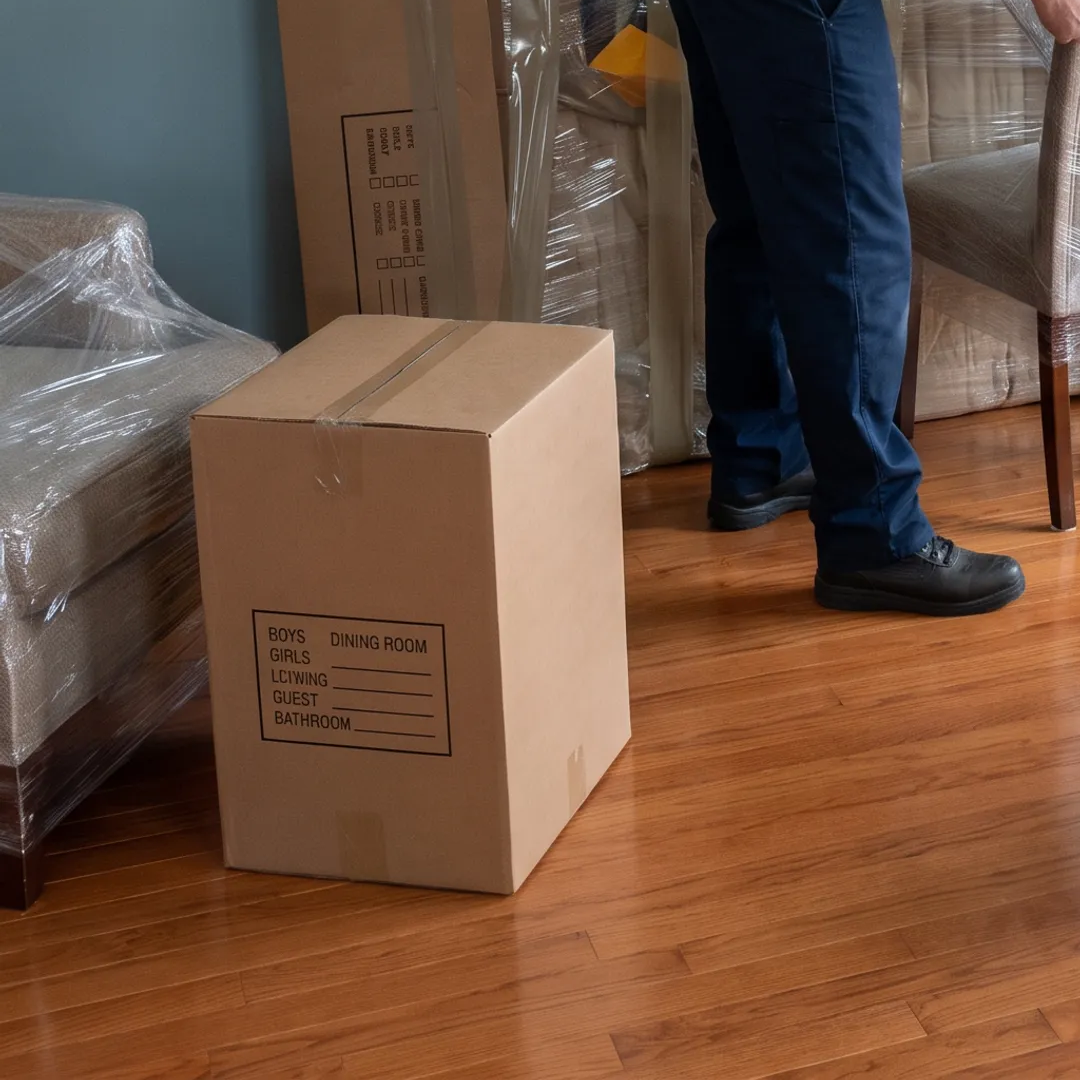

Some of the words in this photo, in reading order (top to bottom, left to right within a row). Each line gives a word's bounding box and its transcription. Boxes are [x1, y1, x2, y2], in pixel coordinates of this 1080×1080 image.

[268, 626, 306, 644] BOYS
[330, 631, 380, 650] DINING
[383, 636, 428, 654] ROOM
[269, 647, 311, 665] GIRLS
[273, 689, 319, 707] GUEST
[274, 710, 351, 731] BATHROOM
